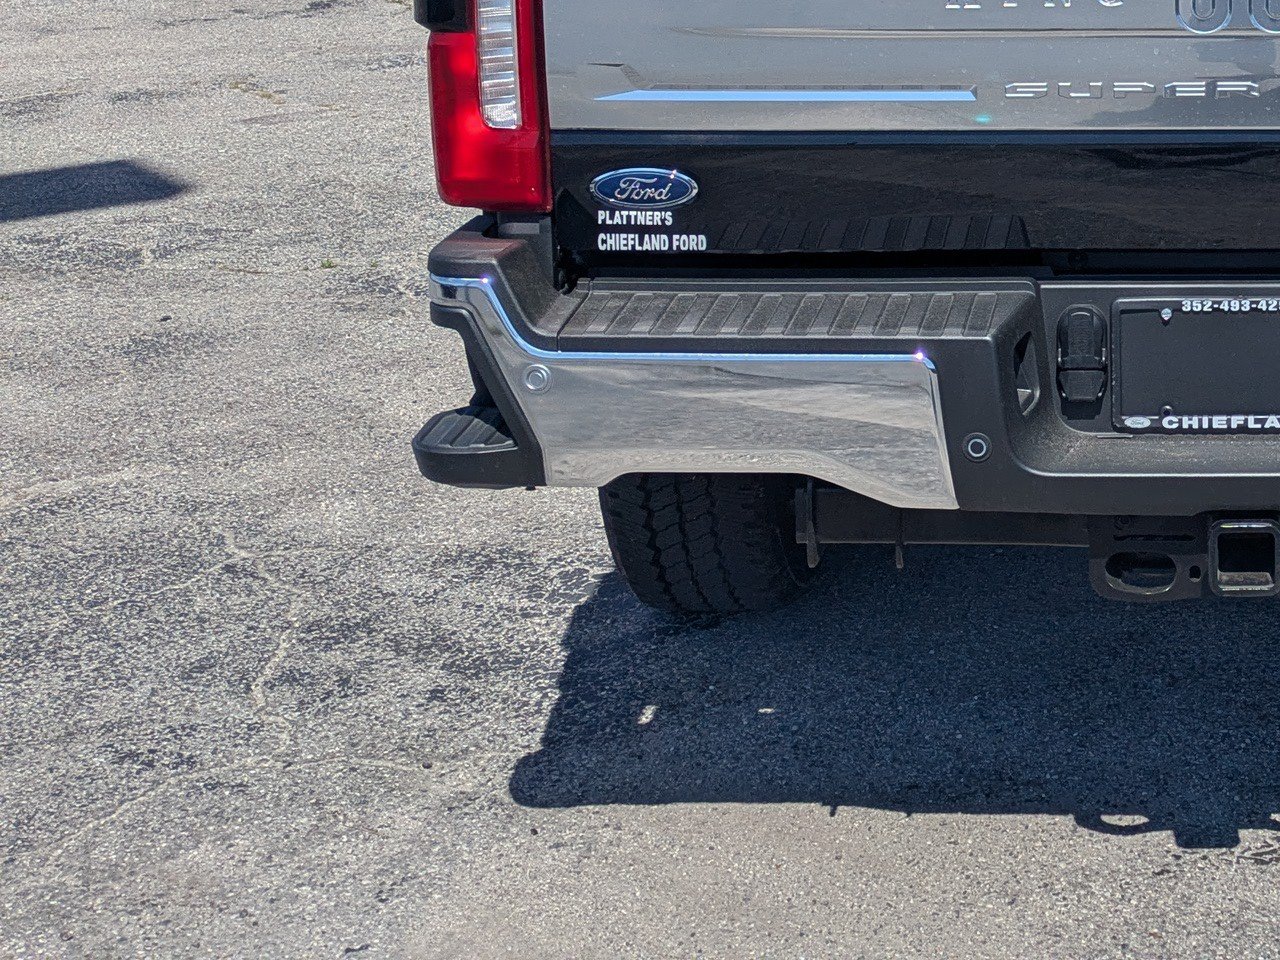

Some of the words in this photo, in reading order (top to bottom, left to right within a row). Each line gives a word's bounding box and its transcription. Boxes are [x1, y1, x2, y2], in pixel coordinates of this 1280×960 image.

[1005, 81, 1259, 99] SUPER
[614, 177, 673, 200] Ford
[597, 210, 673, 226] PLATTNER'S
[597, 232, 669, 251] CHIEFLAND
[672, 234, 707, 251] FORD
